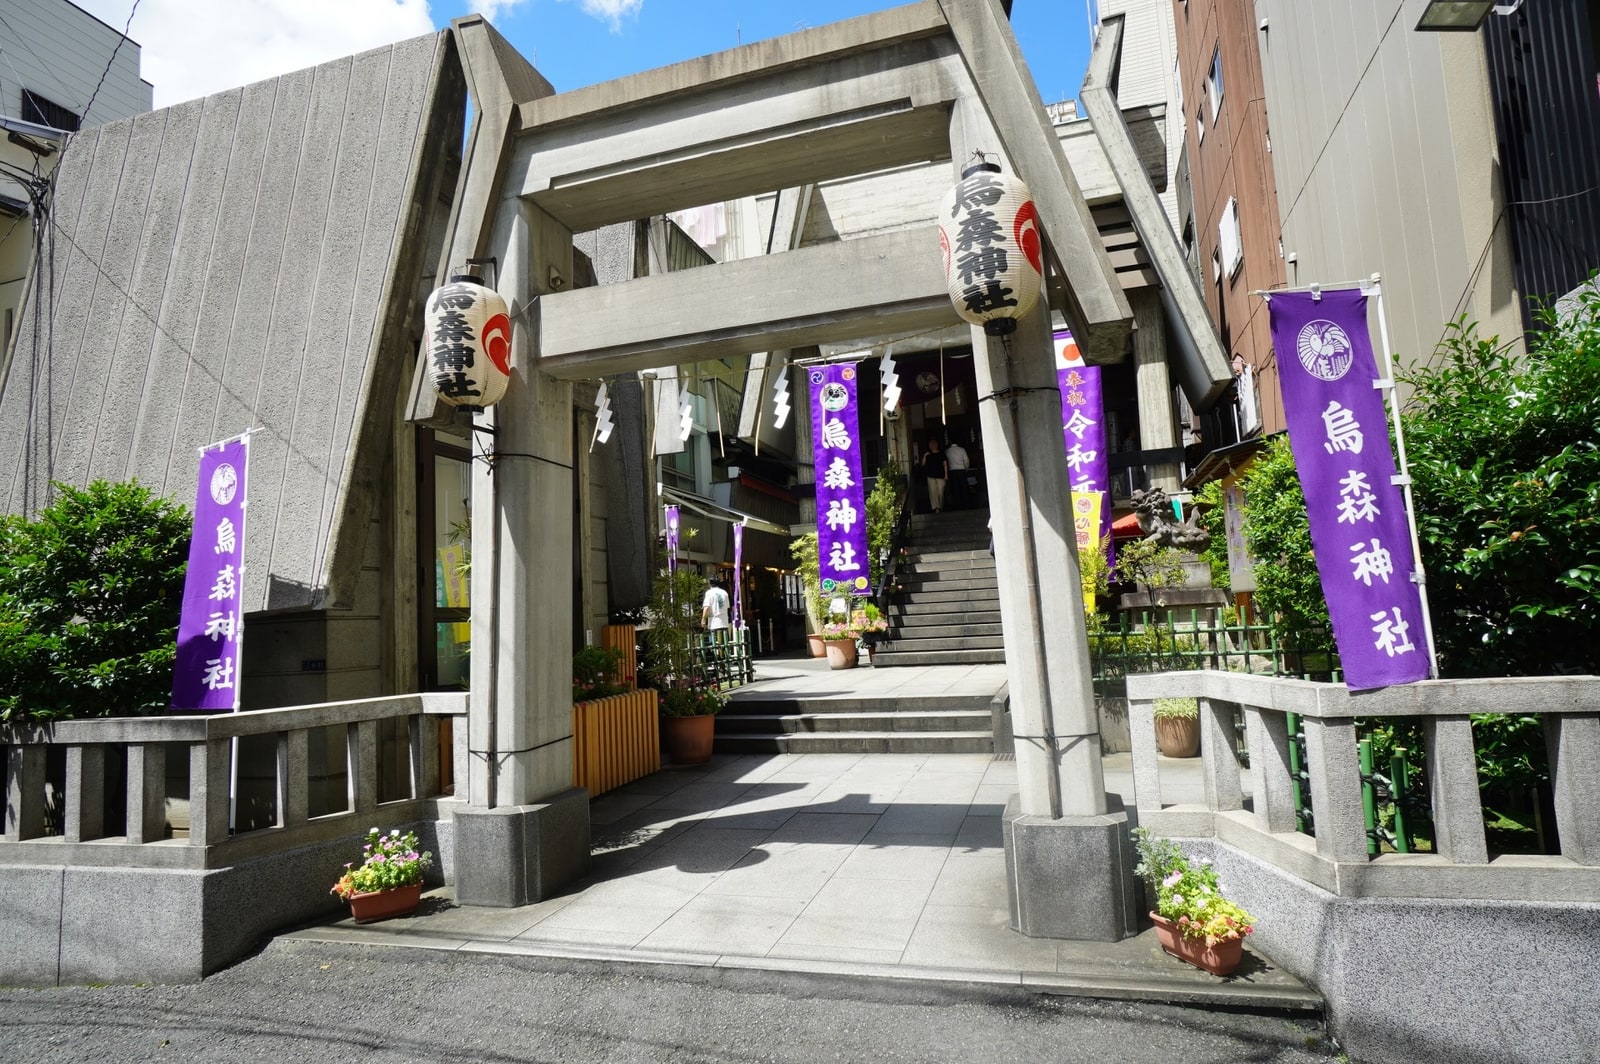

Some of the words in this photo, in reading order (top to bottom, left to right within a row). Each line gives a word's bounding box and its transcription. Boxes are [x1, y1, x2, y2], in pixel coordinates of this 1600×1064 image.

[952, 175, 1018, 314] 烏森神社
[432, 285, 482, 397] 烏森神社
[822, 417, 861, 572] 烏森神社
[1321, 400, 1416, 658] 烏森神社
[201, 517, 236, 690] 烏森神社
